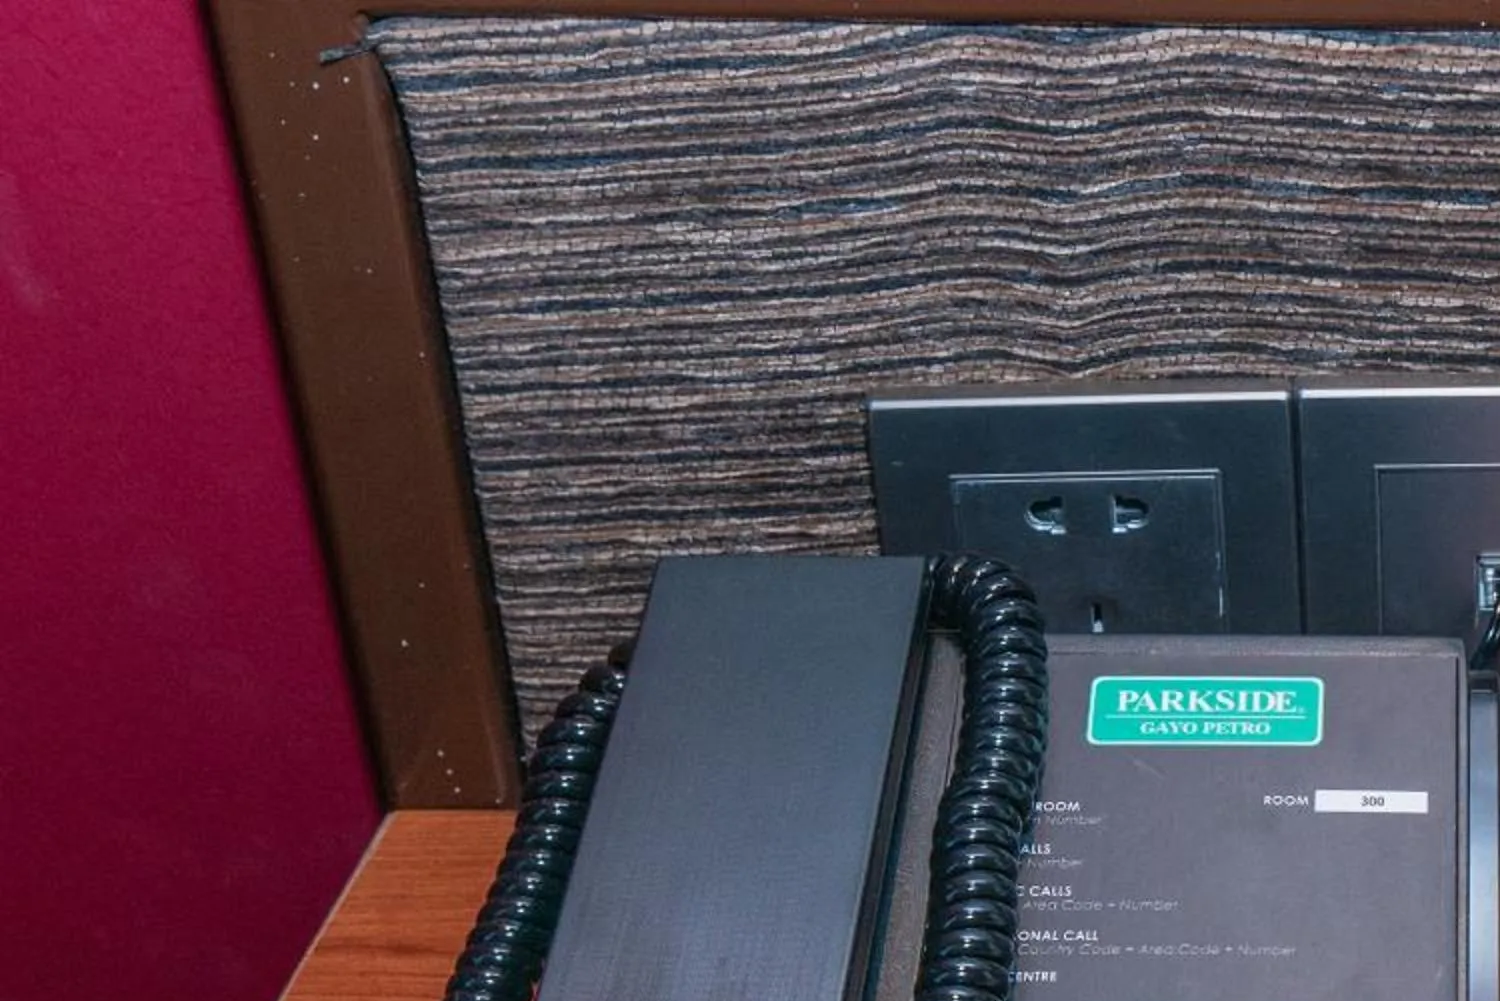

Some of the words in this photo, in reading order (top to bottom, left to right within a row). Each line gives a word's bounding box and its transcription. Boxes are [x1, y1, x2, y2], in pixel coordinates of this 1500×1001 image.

[1117, 690, 1298, 713] PARKSIDE
[1140, 721, 1197, 736] GAYO
[1203, 721, 1271, 736] PETRO
[1035, 801, 1081, 812] ROOM
[1263, 795, 1309, 806] ROOM
[1360, 795, 1385, 807] 300
[1020, 844, 1051, 855] ALLS
[1029, 886, 1072, 897] CALLS
[1061, 900, 1103, 911] Code
[1119, 900, 1180, 911] Number
[1063, 930, 1099, 941] CALL
